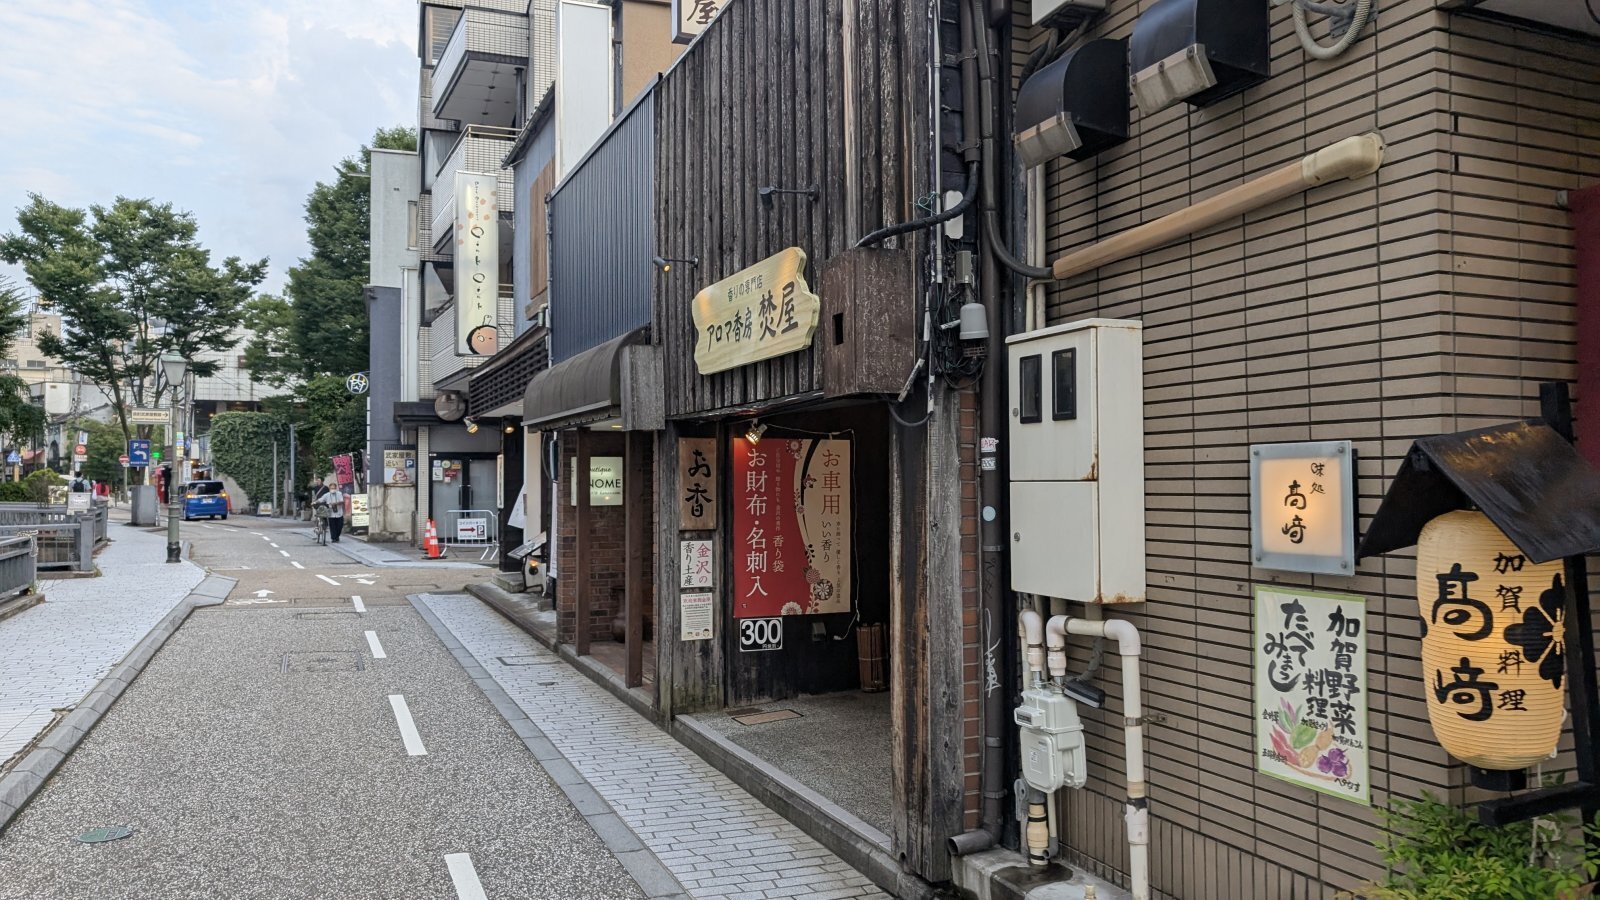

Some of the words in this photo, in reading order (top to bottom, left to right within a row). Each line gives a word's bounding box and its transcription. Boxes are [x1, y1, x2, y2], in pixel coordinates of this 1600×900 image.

[727, 274, 763, 303] 香りの専門店
[706, 307, 753, 353] アロマ香房
[758, 280, 799, 342] 焚屋
[590, 466, 612, 476] utique
[685, 449, 712, 518] お香
[820, 449, 841, 515] お車用
[1310, 462, 1327, 496] 味処
[746, 448, 768, 598] お財布・名刺入
[821, 520, 833, 563] いい香り
[682, 542, 695, 586] 香り土産
[696, 543, 712, 584] 金沢の
[772, 534, 785, 573] 香り袋
[741, 619, 781, 646] 300
[1280, 598, 1316, 668] たべて
[1493, 552, 1528, 712] 加賀料理
[1302, 668, 1328, 720] 料理
[1326, 604, 1361, 736] 加賀野菜
